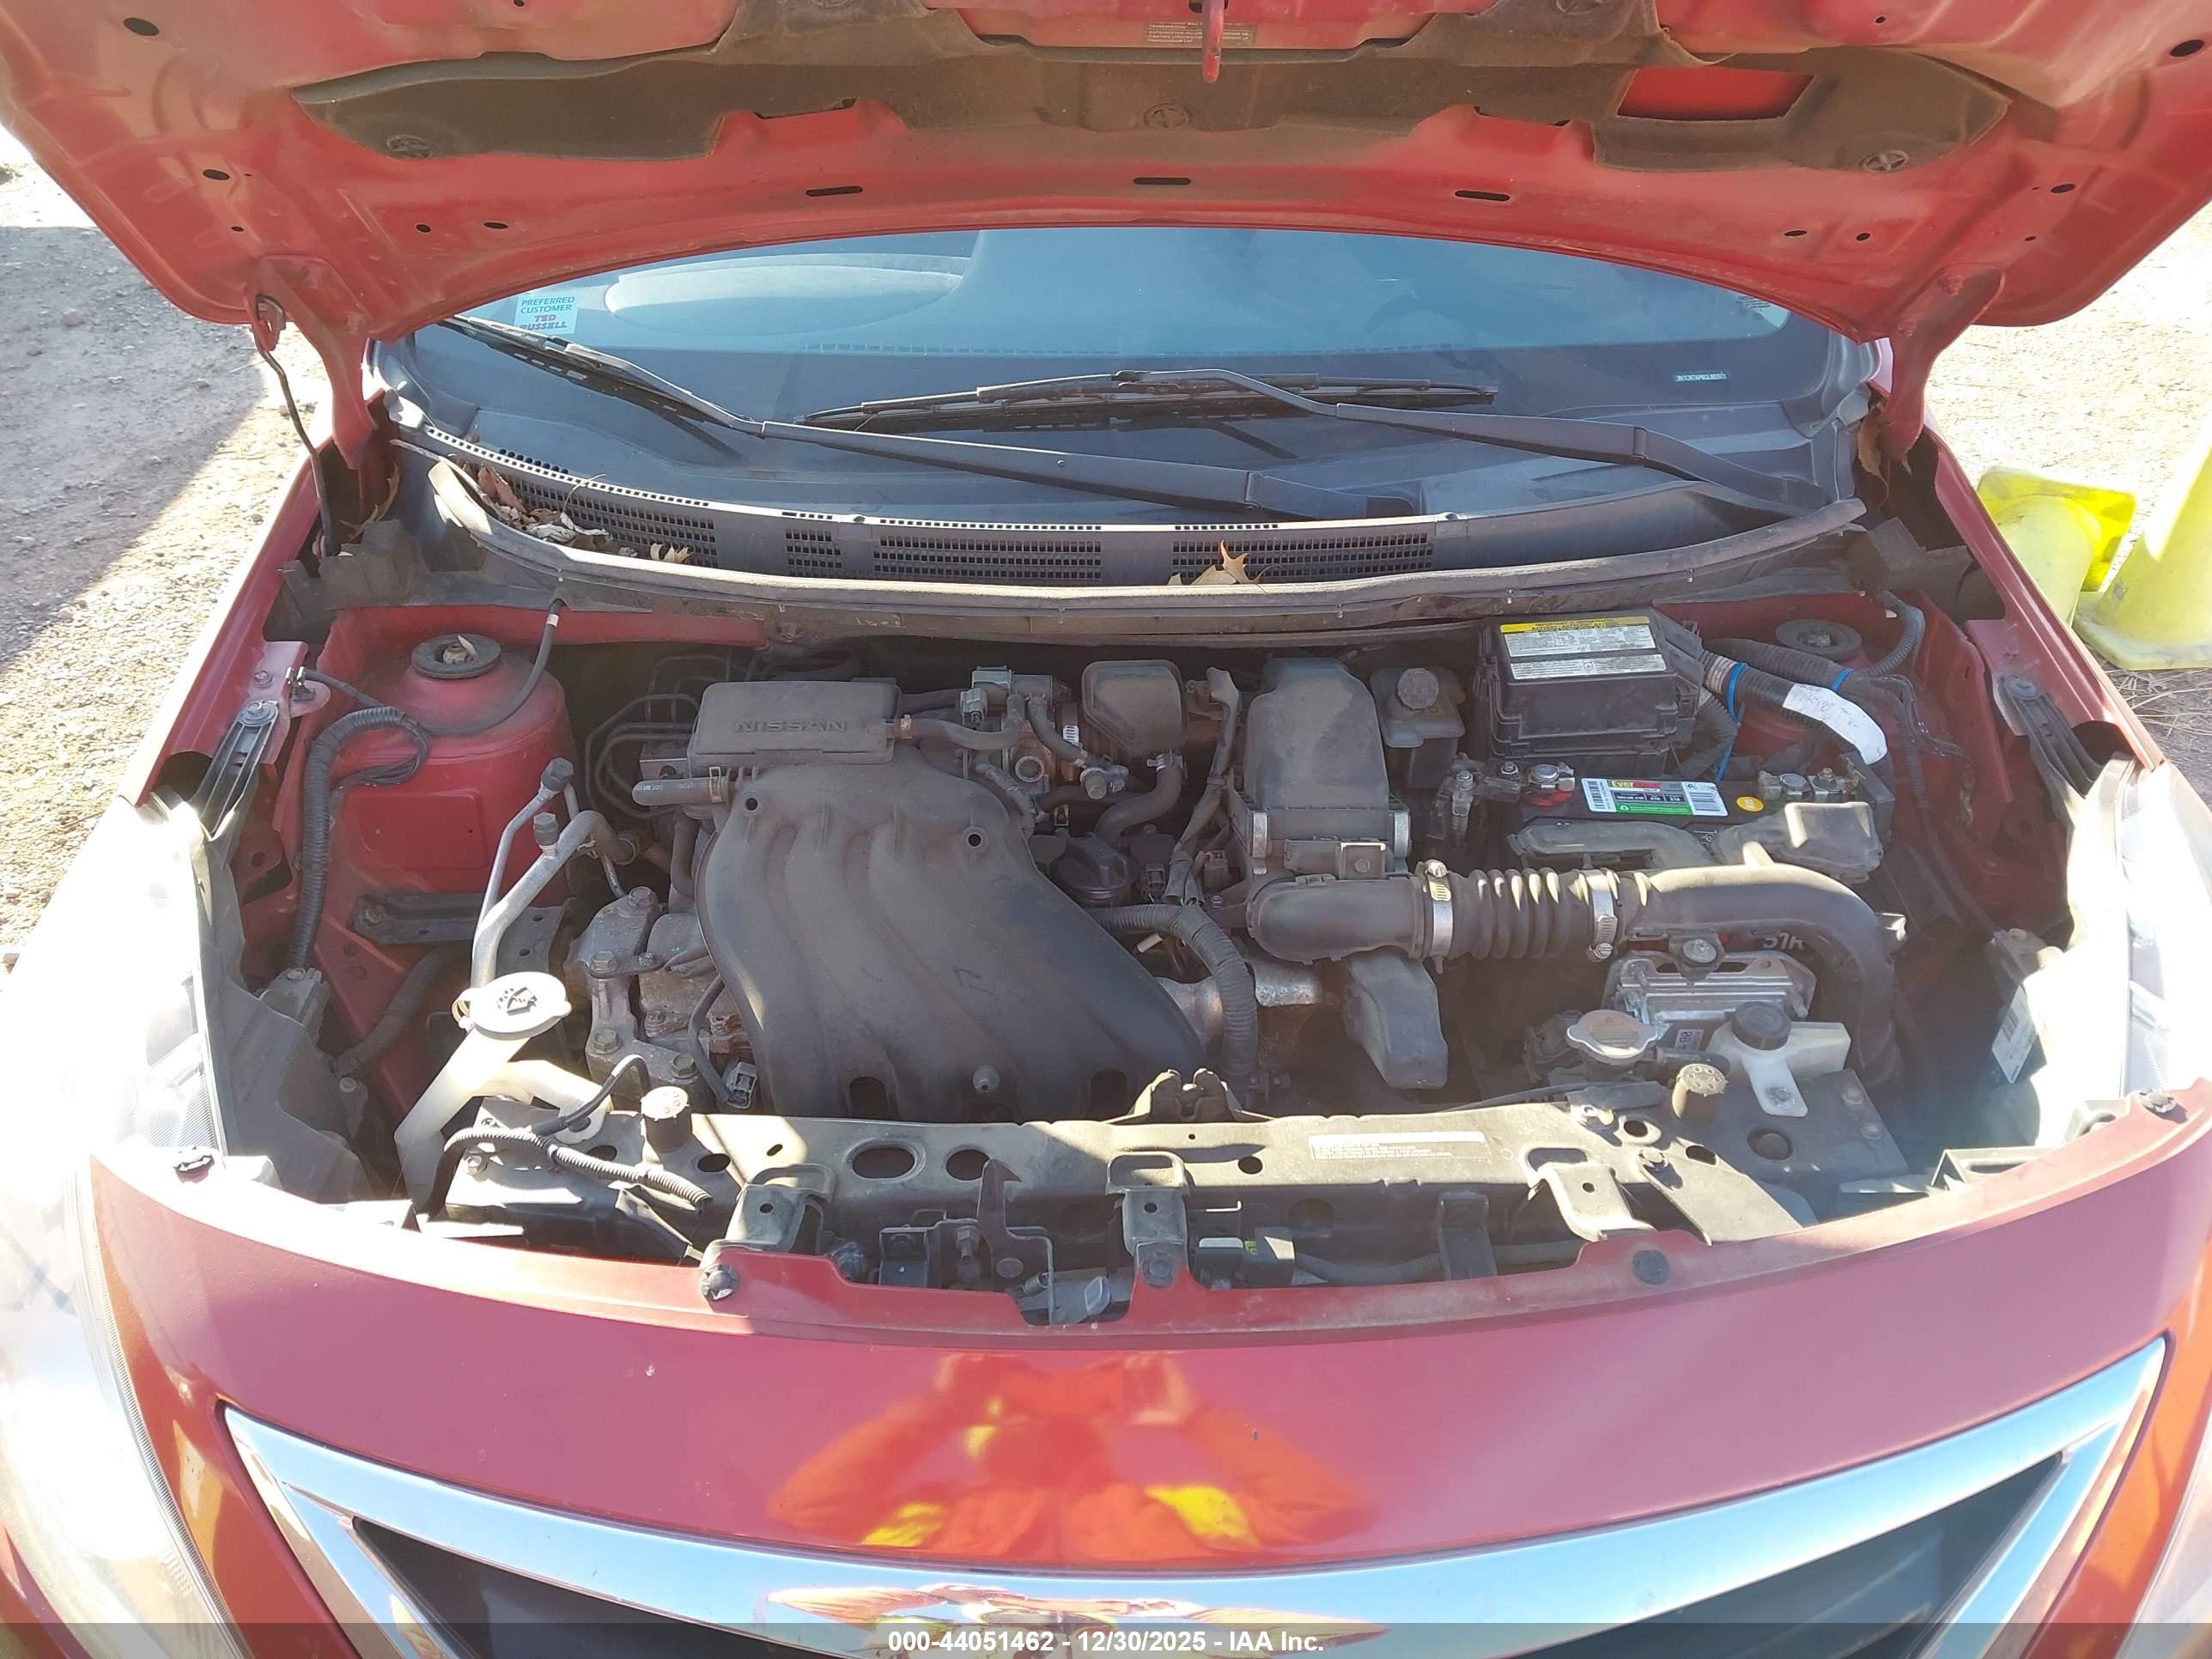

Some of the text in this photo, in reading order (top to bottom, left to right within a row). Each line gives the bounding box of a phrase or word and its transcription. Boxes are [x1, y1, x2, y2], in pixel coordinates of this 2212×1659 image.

[521, 296, 575, 307] PREFERRED
[520, 304, 573, 314] CUSTOMER
[534, 314, 556, 323] TED
[520, 321, 568, 331] RUSSELL
[734, 720, 847, 733] NISSAN
